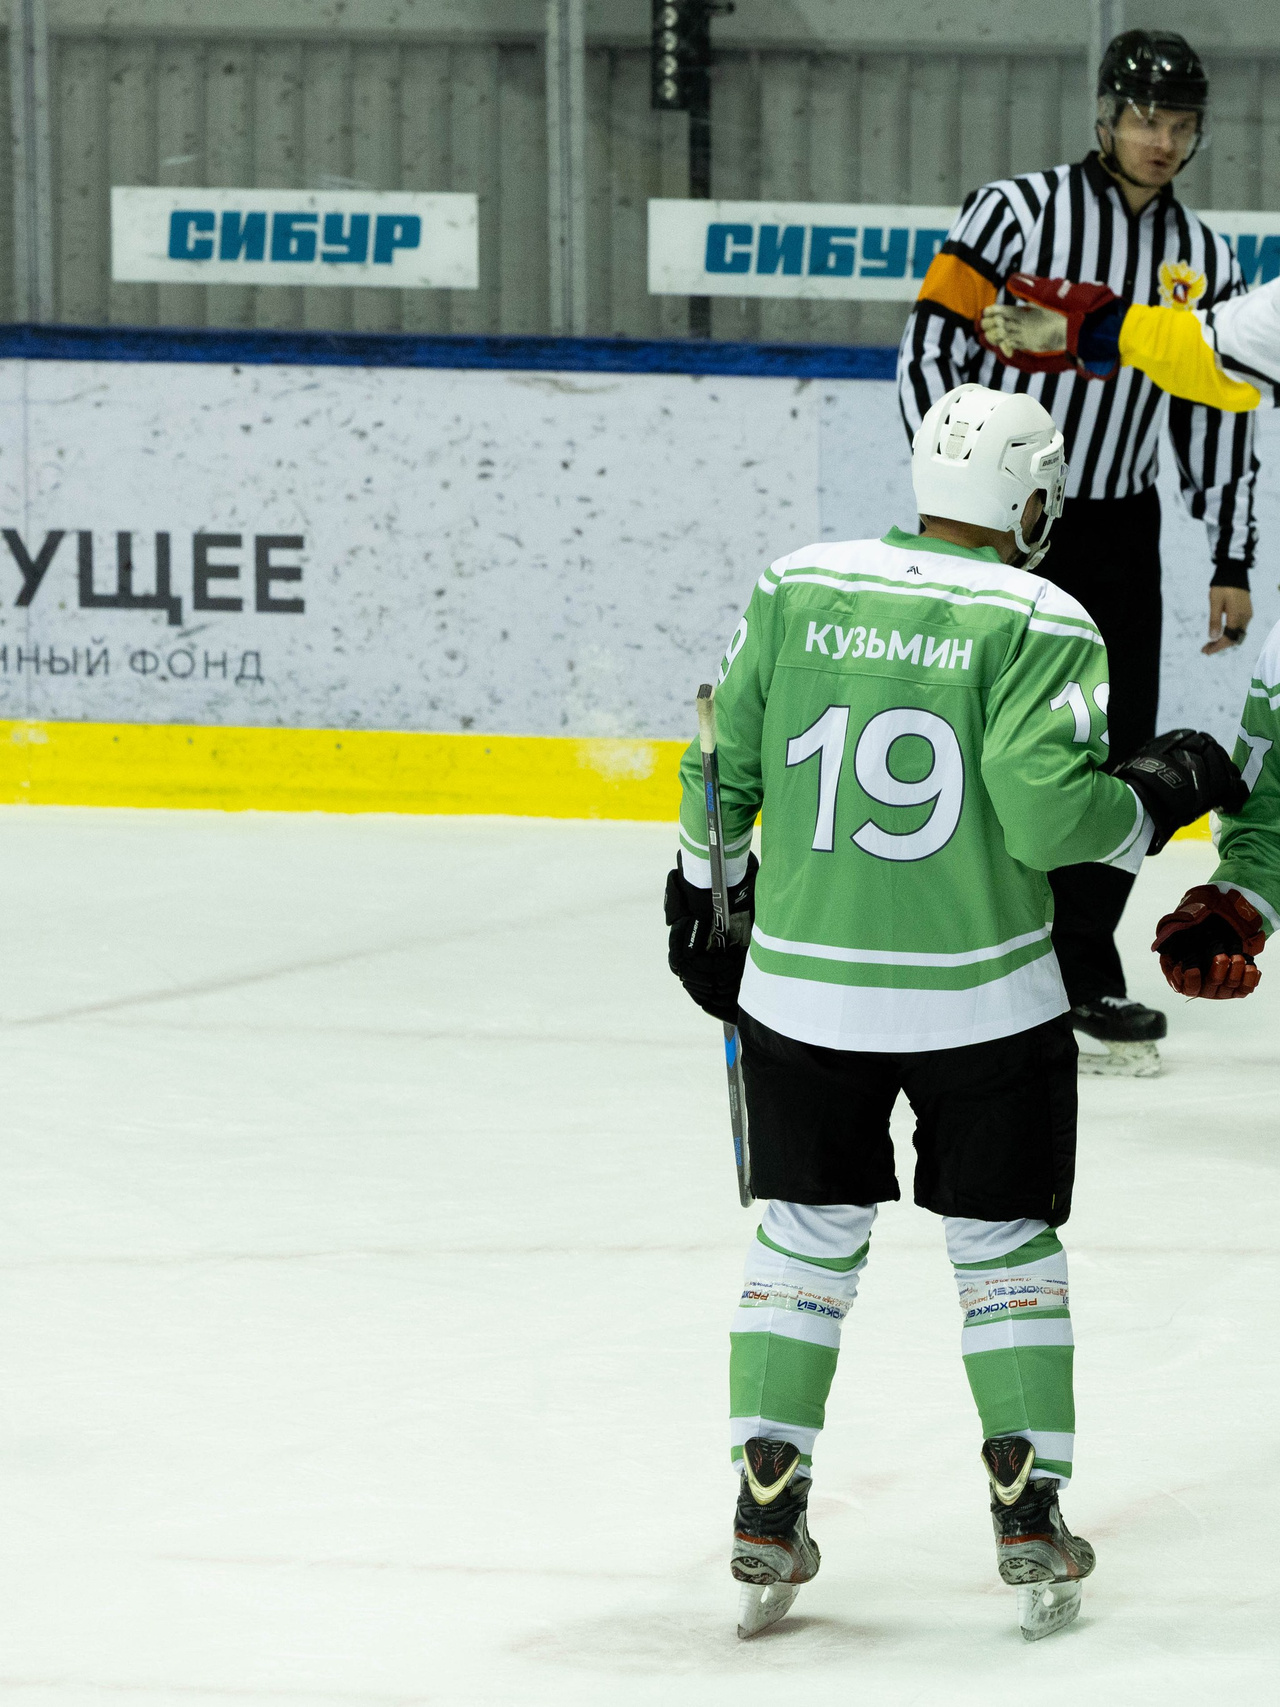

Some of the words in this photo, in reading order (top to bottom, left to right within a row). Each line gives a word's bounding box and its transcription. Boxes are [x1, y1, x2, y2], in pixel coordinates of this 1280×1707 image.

[168, 211, 422, 264] СИБУР
[0, 528, 305, 626] УЩЕЕ
[129, 649, 264, 685] ФОНД
[805, 621, 973, 671] КУЗЬМИН
[705, 781, 715, 812] NEXUS
[785, 704, 966, 862] 19
